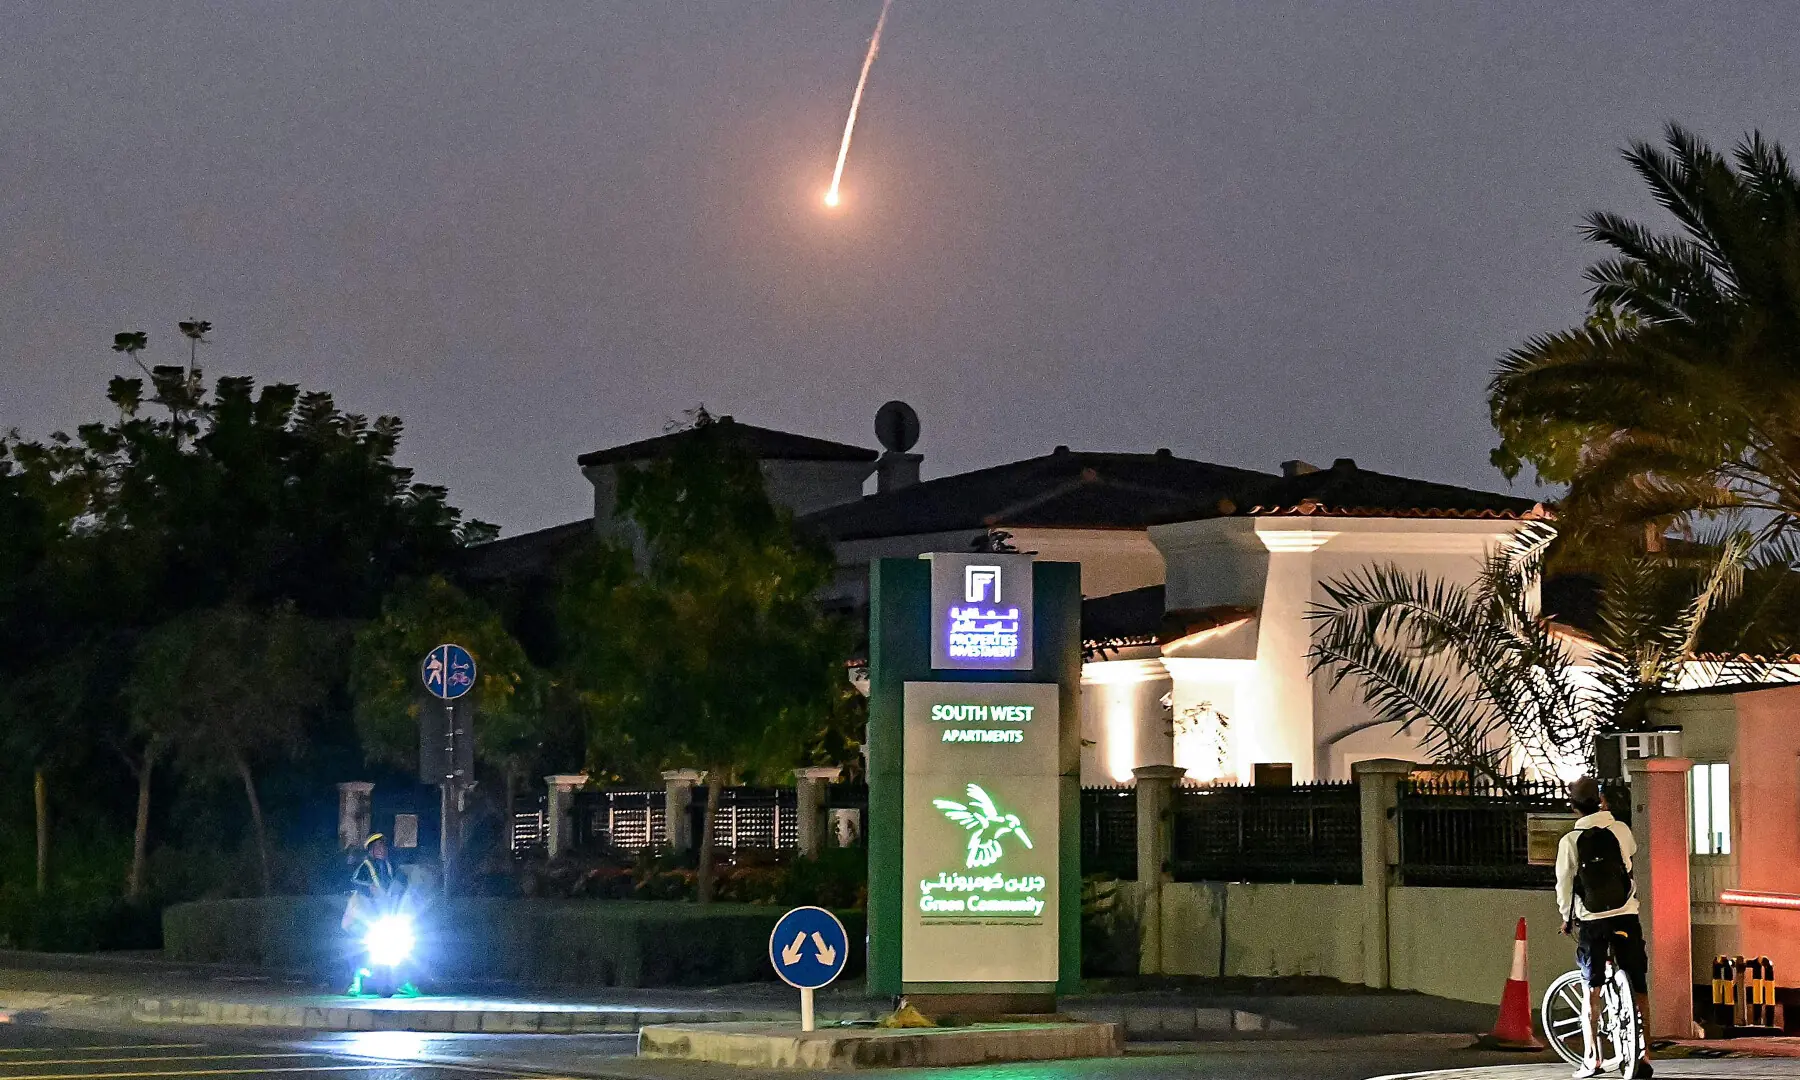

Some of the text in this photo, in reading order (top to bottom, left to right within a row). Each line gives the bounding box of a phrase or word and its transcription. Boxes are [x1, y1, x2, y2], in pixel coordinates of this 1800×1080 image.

[931, 704, 1035, 722] SOUTH WEST
[941, 729, 1024, 743] APARTMENTS
[919, 894, 1045, 917] Green Community
